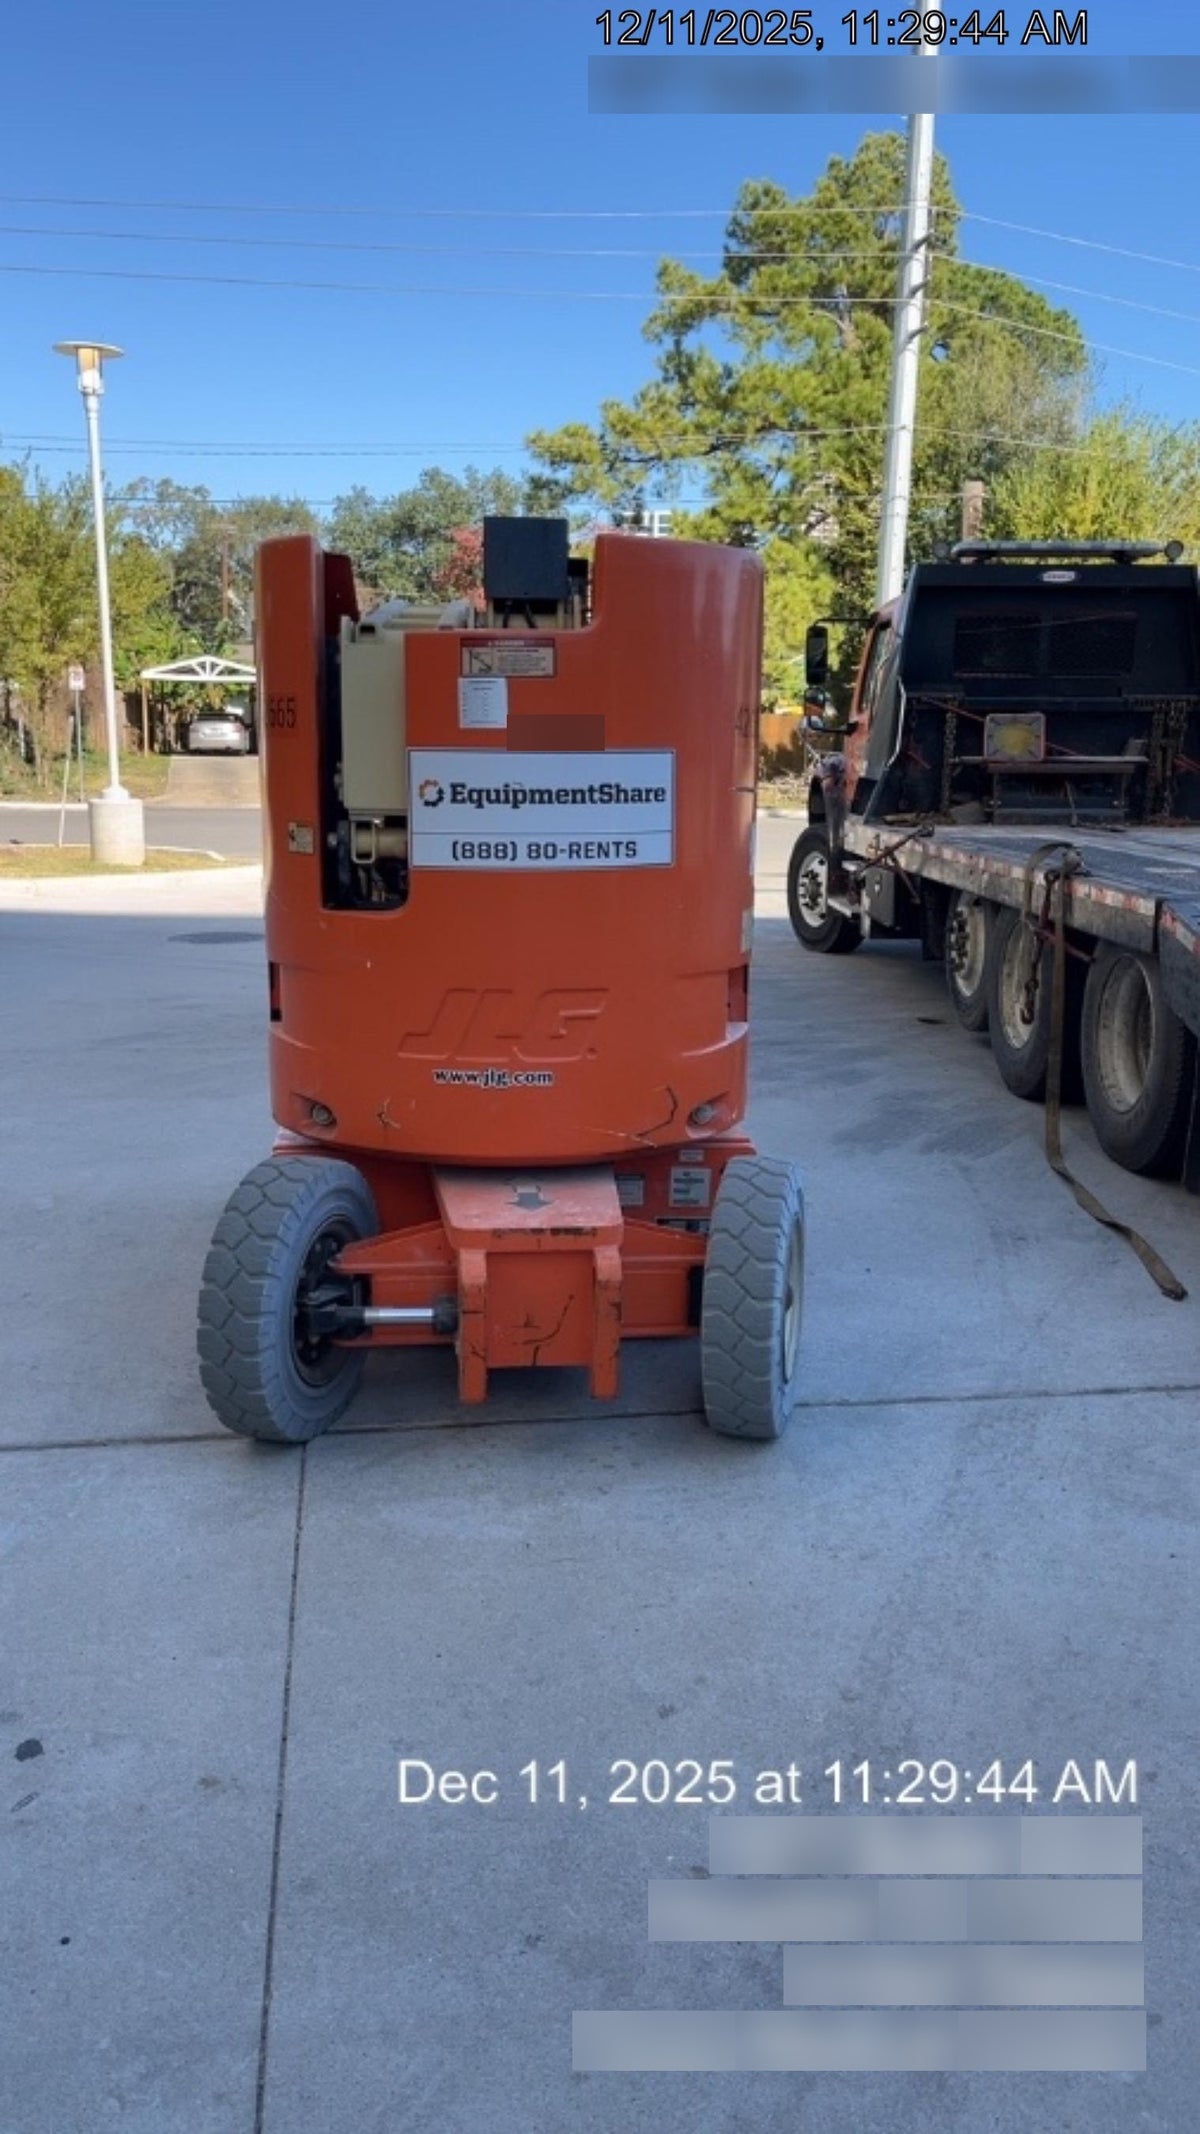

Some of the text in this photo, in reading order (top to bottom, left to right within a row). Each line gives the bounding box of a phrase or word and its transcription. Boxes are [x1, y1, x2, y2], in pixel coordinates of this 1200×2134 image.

[450, 782, 667, 809] EquipmentShare
[452, 841, 637, 862] (888) 80-RENTS
[398, 988, 608, 1062] JLG
[433, 1070, 554, 1088] www.jlg.com
